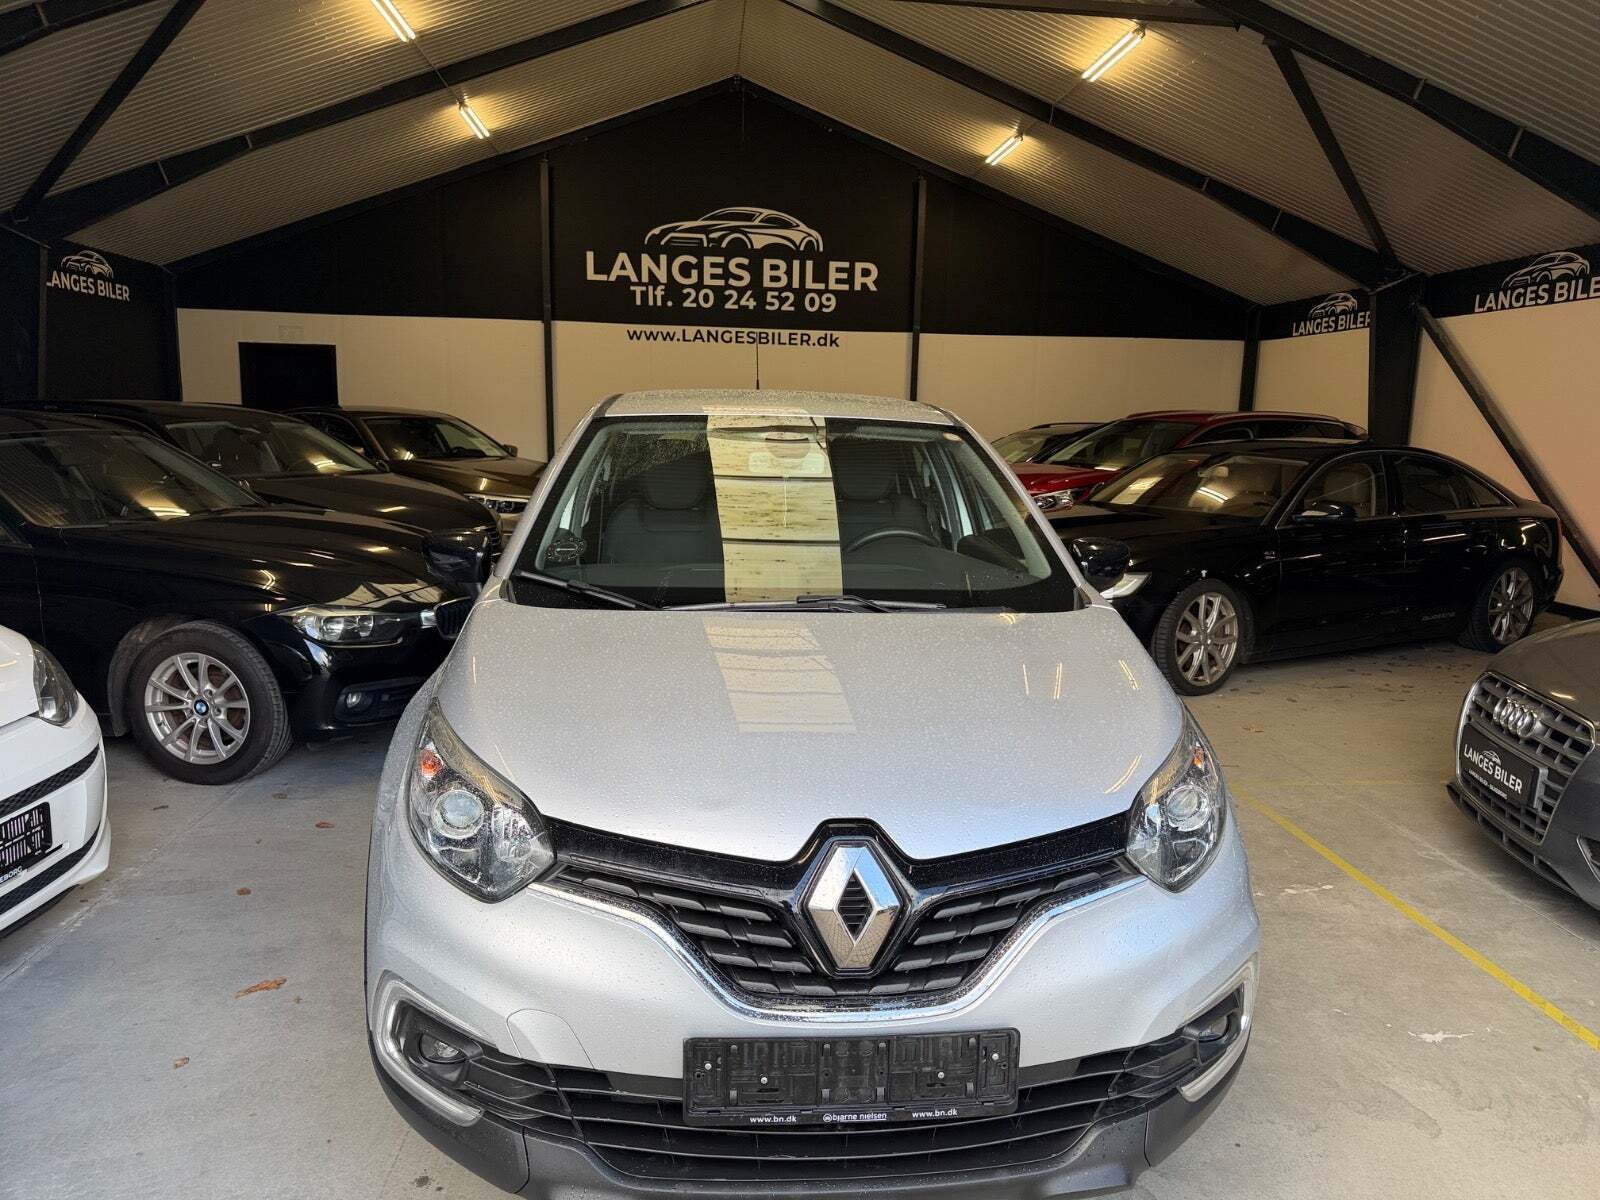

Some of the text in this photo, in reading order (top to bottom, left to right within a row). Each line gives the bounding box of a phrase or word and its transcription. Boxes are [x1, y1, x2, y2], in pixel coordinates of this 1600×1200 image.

[585, 250, 879, 292] LANGES BILER
[97, 279, 130, 302] BILER
[630, 285, 838, 313] Tlf. 20 24 52 09
[1474, 284, 1550, 313] LANGES
[1292, 316, 1336, 337] LANGES
[626, 328, 840, 348] www.LANGESBILER.dk
[1463, 744, 1494, 775] LANGES
[1494, 765, 1523, 794] BILER
[749, 1114, 797, 1124] www.bn.dk
[832, 1113, 858, 1122] bjarne
[859, 1112, 887, 1121] nielsen
[911, 1109, 958, 1119] www.bn.dk
